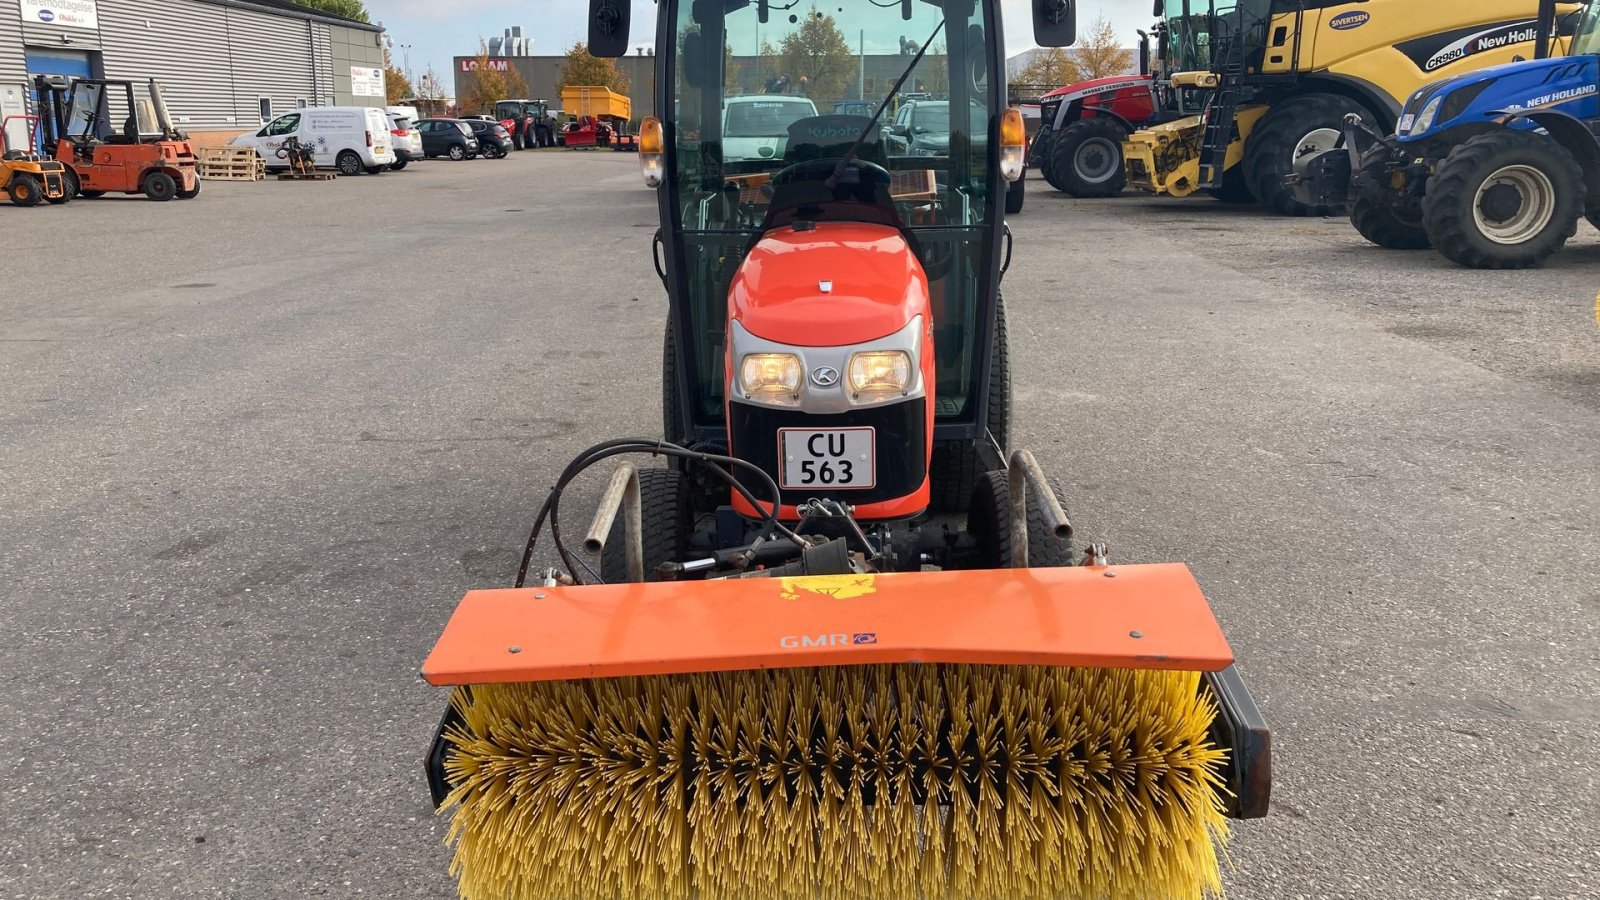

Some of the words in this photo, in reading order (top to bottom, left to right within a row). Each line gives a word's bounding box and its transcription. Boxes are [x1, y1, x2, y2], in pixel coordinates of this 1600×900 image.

[1331, 13, 1368, 27] SIVERTSEN
[1478, 36, 1507, 51] New
[462, 60, 508, 71] LOAM
[1427, 48, 1462, 69] CR980
[1082, 87, 1104, 96] MASSEY
[1105, 82, 1134, 91] FERGUSON
[1527, 94, 1551, 108] NEW
[1552, 84, 1597, 101] HOLLAND
[807, 433, 845, 457] CU
[801, 460, 853, 484] 563
[780, 633, 849, 649] GMR
